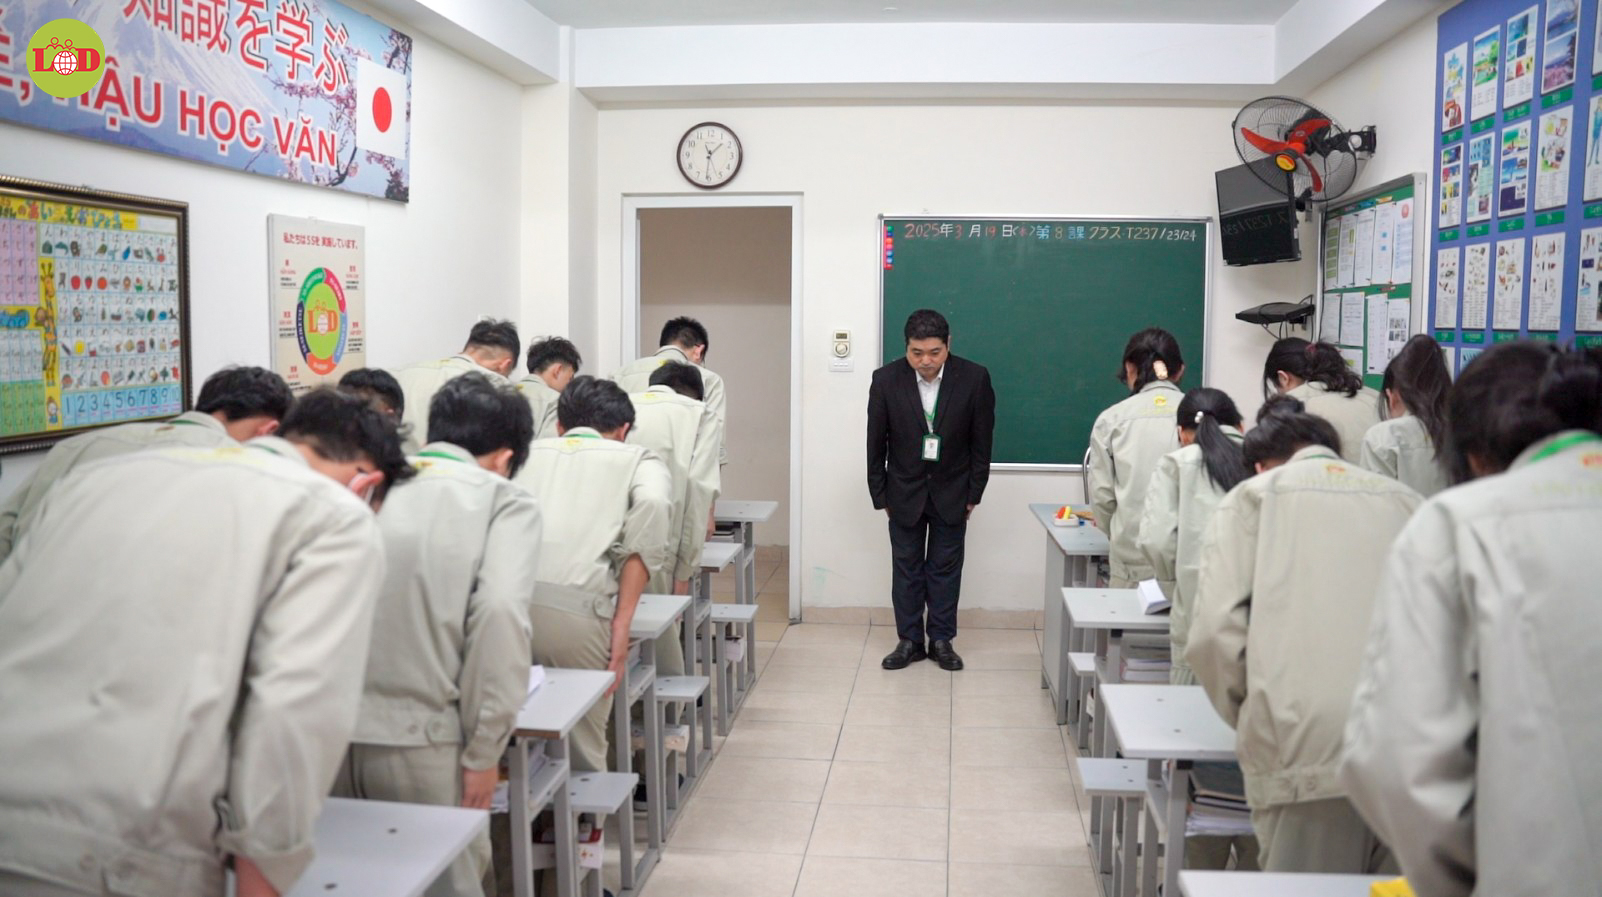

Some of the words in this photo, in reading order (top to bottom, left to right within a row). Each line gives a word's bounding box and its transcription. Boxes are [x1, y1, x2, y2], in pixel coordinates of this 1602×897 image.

[180, 90, 262, 151] HỌC
[273, 116, 336, 166] VĂN
[78, 396, 86, 413] 2
[90, 394, 98, 411] 3
[102, 393, 110, 410] 4
[116, 392, 123, 408] 5
[128, 390, 136, 407] 6
[138, 390, 147, 405] 7
[151, 388, 158, 404] 8
[162, 388, 168, 403] 9
